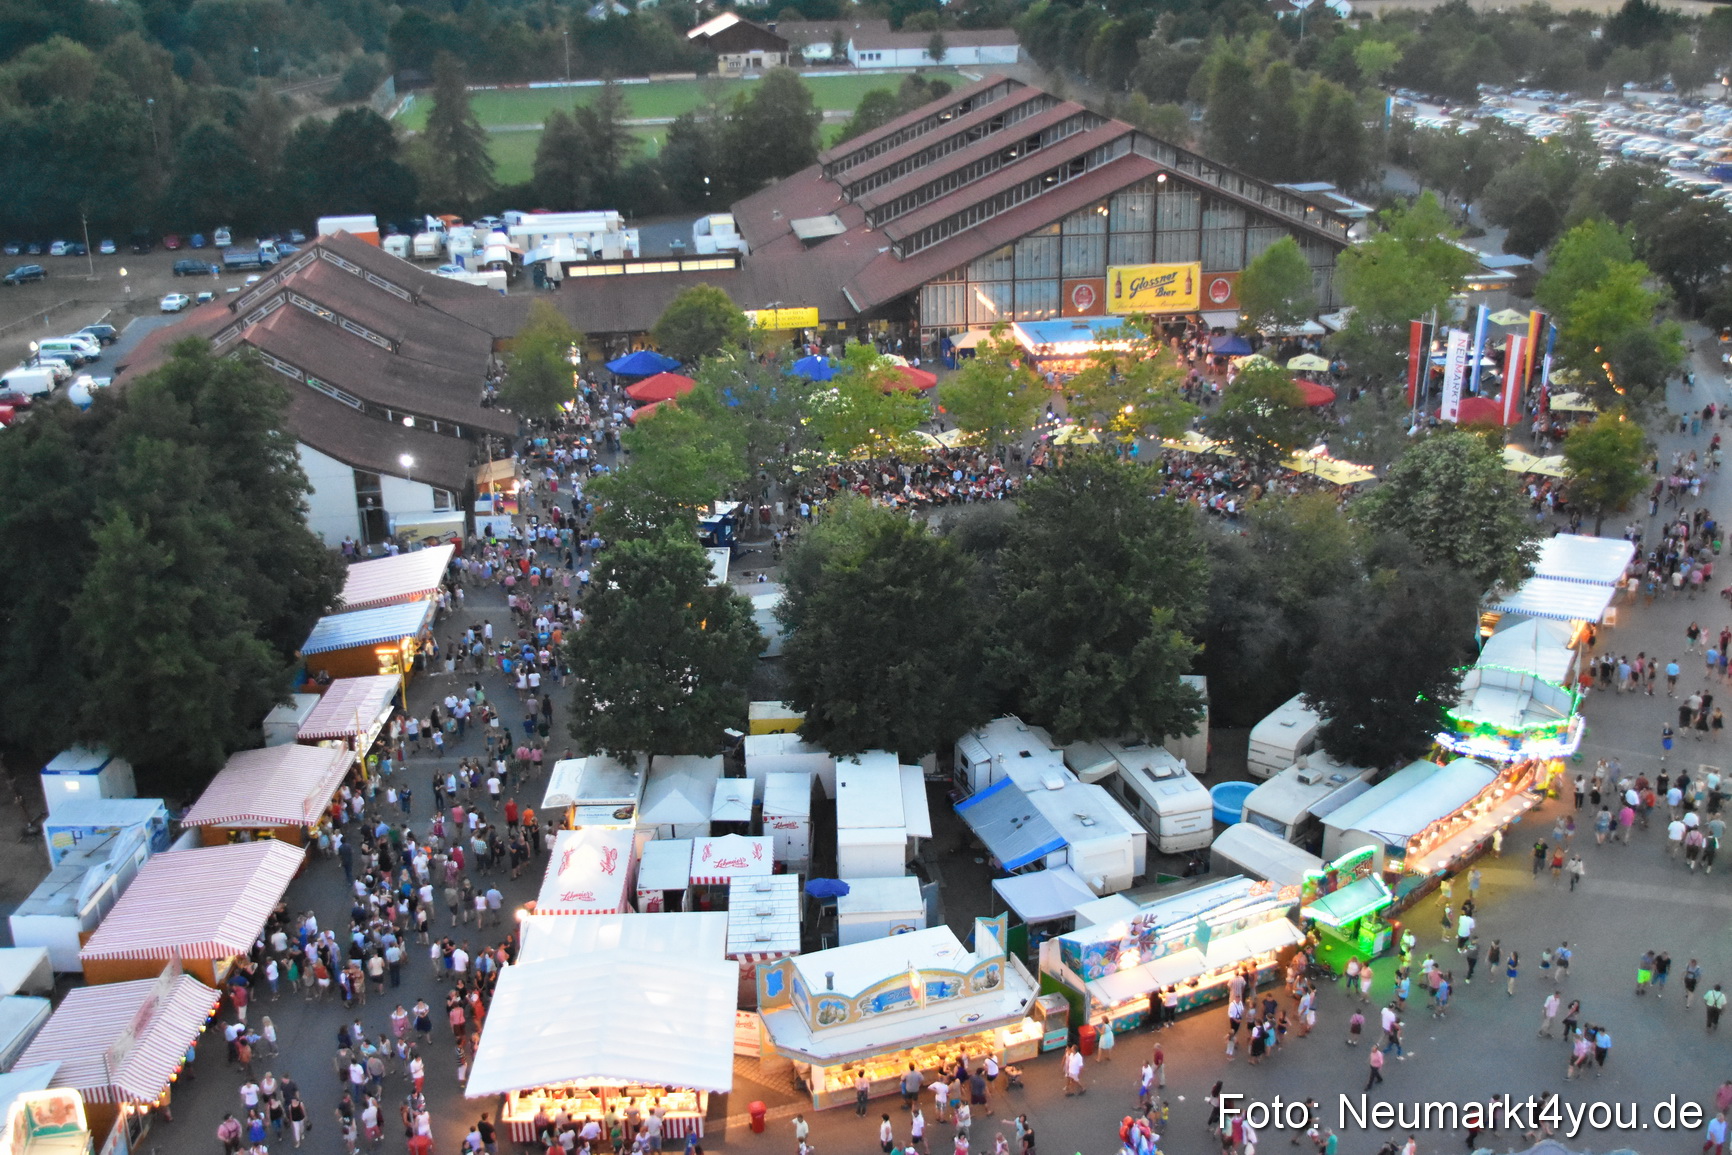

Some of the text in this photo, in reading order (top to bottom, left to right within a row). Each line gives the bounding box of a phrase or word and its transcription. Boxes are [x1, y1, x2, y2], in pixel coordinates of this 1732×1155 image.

[1129, 271, 1178, 299] Glossner
[1155, 287, 1177, 297] Bier
[1450, 339, 1466, 406] NEUMARKT
